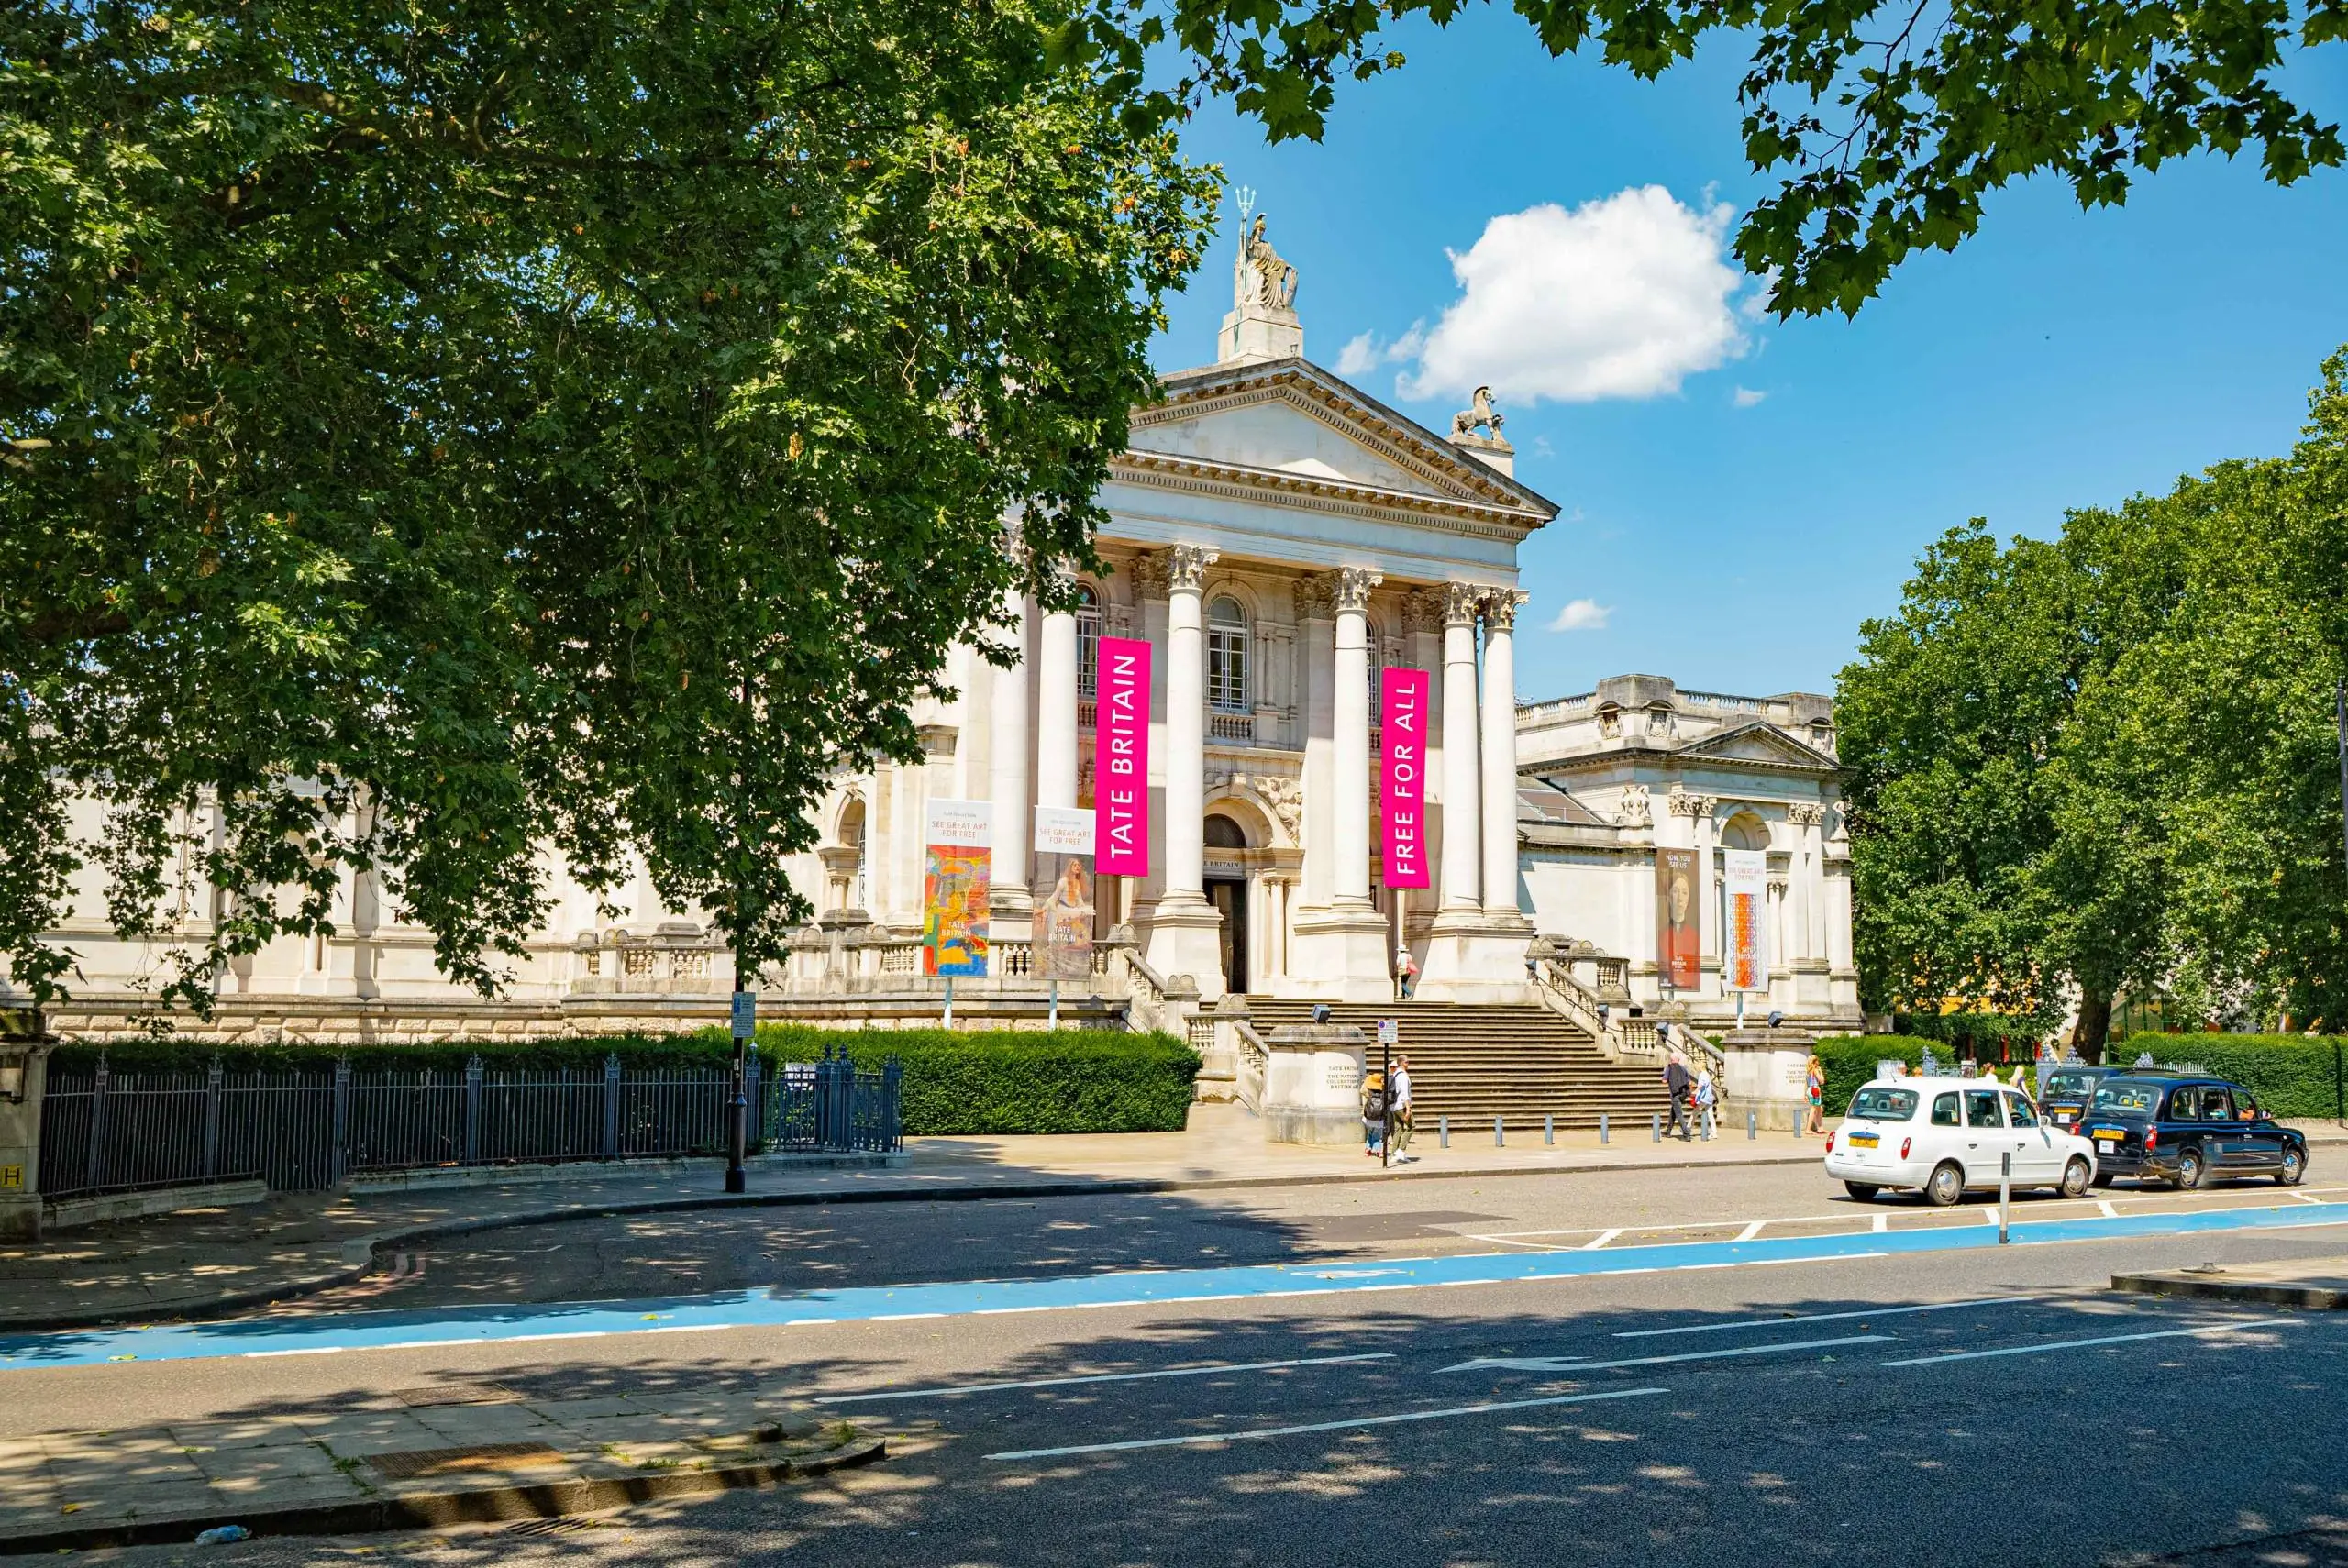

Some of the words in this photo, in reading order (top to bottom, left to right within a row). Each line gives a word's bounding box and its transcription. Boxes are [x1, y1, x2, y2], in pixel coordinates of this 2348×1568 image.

[1394, 682, 1415, 733] ALL
[1111, 655, 1135, 775] BRITAIN
[1394, 745, 1414, 799] FOR
[931, 821, 946, 829] SEE
[947, 822, 970, 830] GREAT
[973, 823, 988, 831] ART
[1111, 790, 1134, 859] TATE
[958, 830, 977, 839] FREE
[1038, 828, 1052, 836] SEE
[1049, 836, 1063, 845] FOR
[1064, 837, 1081, 845] FREE
[1396, 812, 1416, 875] FREE
[1210, 860, 1240, 868] BRITAIN
[947, 921, 966, 929] TATE
[1054, 925, 1071, 933] TATE
[941, 929, 972, 937] BRITAIN
[1047, 933, 1077, 943] BRITAIN
[5, 1168, 19, 1185] H
